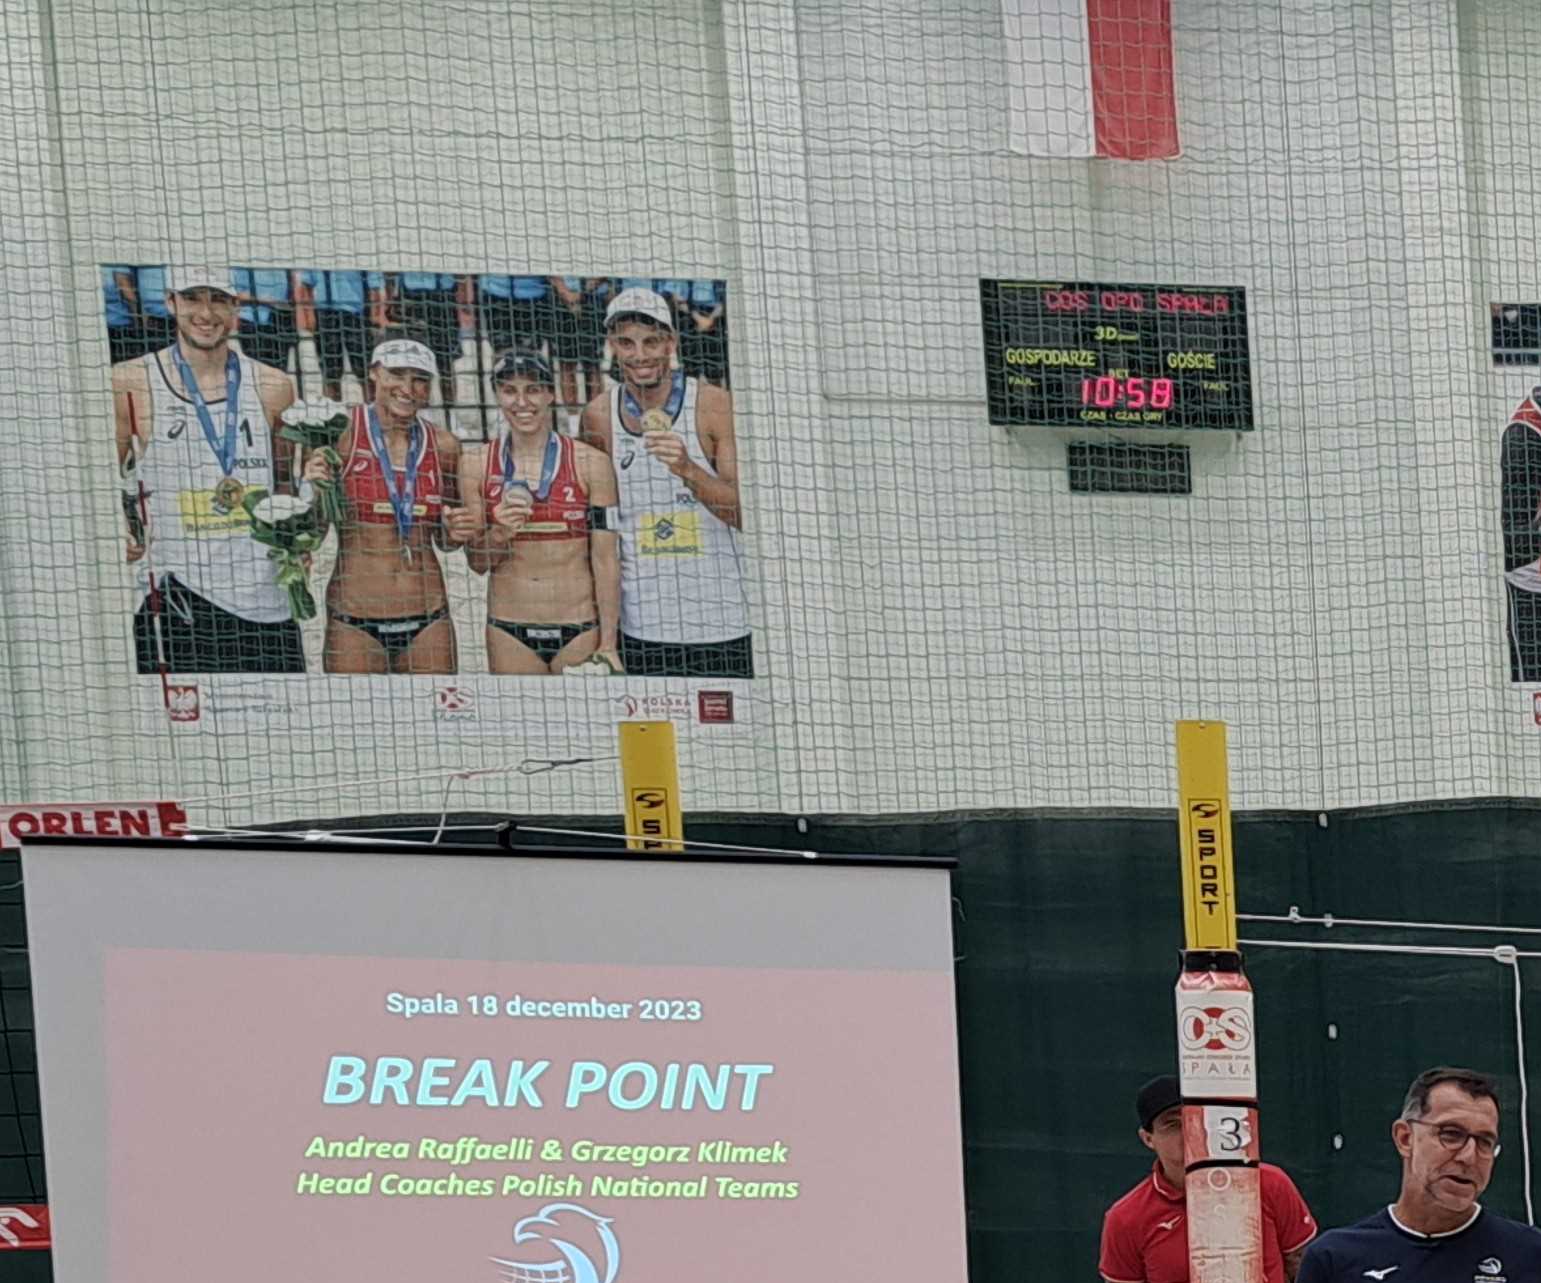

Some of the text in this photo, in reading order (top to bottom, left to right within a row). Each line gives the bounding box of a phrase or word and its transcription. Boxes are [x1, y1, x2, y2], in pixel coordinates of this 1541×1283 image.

[1006, 348, 1216, 369] GOSPODARZE GOŚCIE
[1081, 377, 1172, 409] 10:58
[240, 418, 253, 447] 1
[562, 486, 576, 502] 2
[8, 809, 150, 838] ORLEN
[1196, 829, 1217, 916] SPORT
[385, 992, 703, 1021] Spala 18 december 2023
[322, 1055, 774, 1111] BREAK POINT
[1183, 1062, 1250, 1075] PAŁA
[1219, 1117, 1242, 1151] 3
[304, 1136, 788, 1167] Andrea Raffaelli & Grzegorz Klimek
[297, 1172, 799, 1200] Head Coaches Polish National Teams
